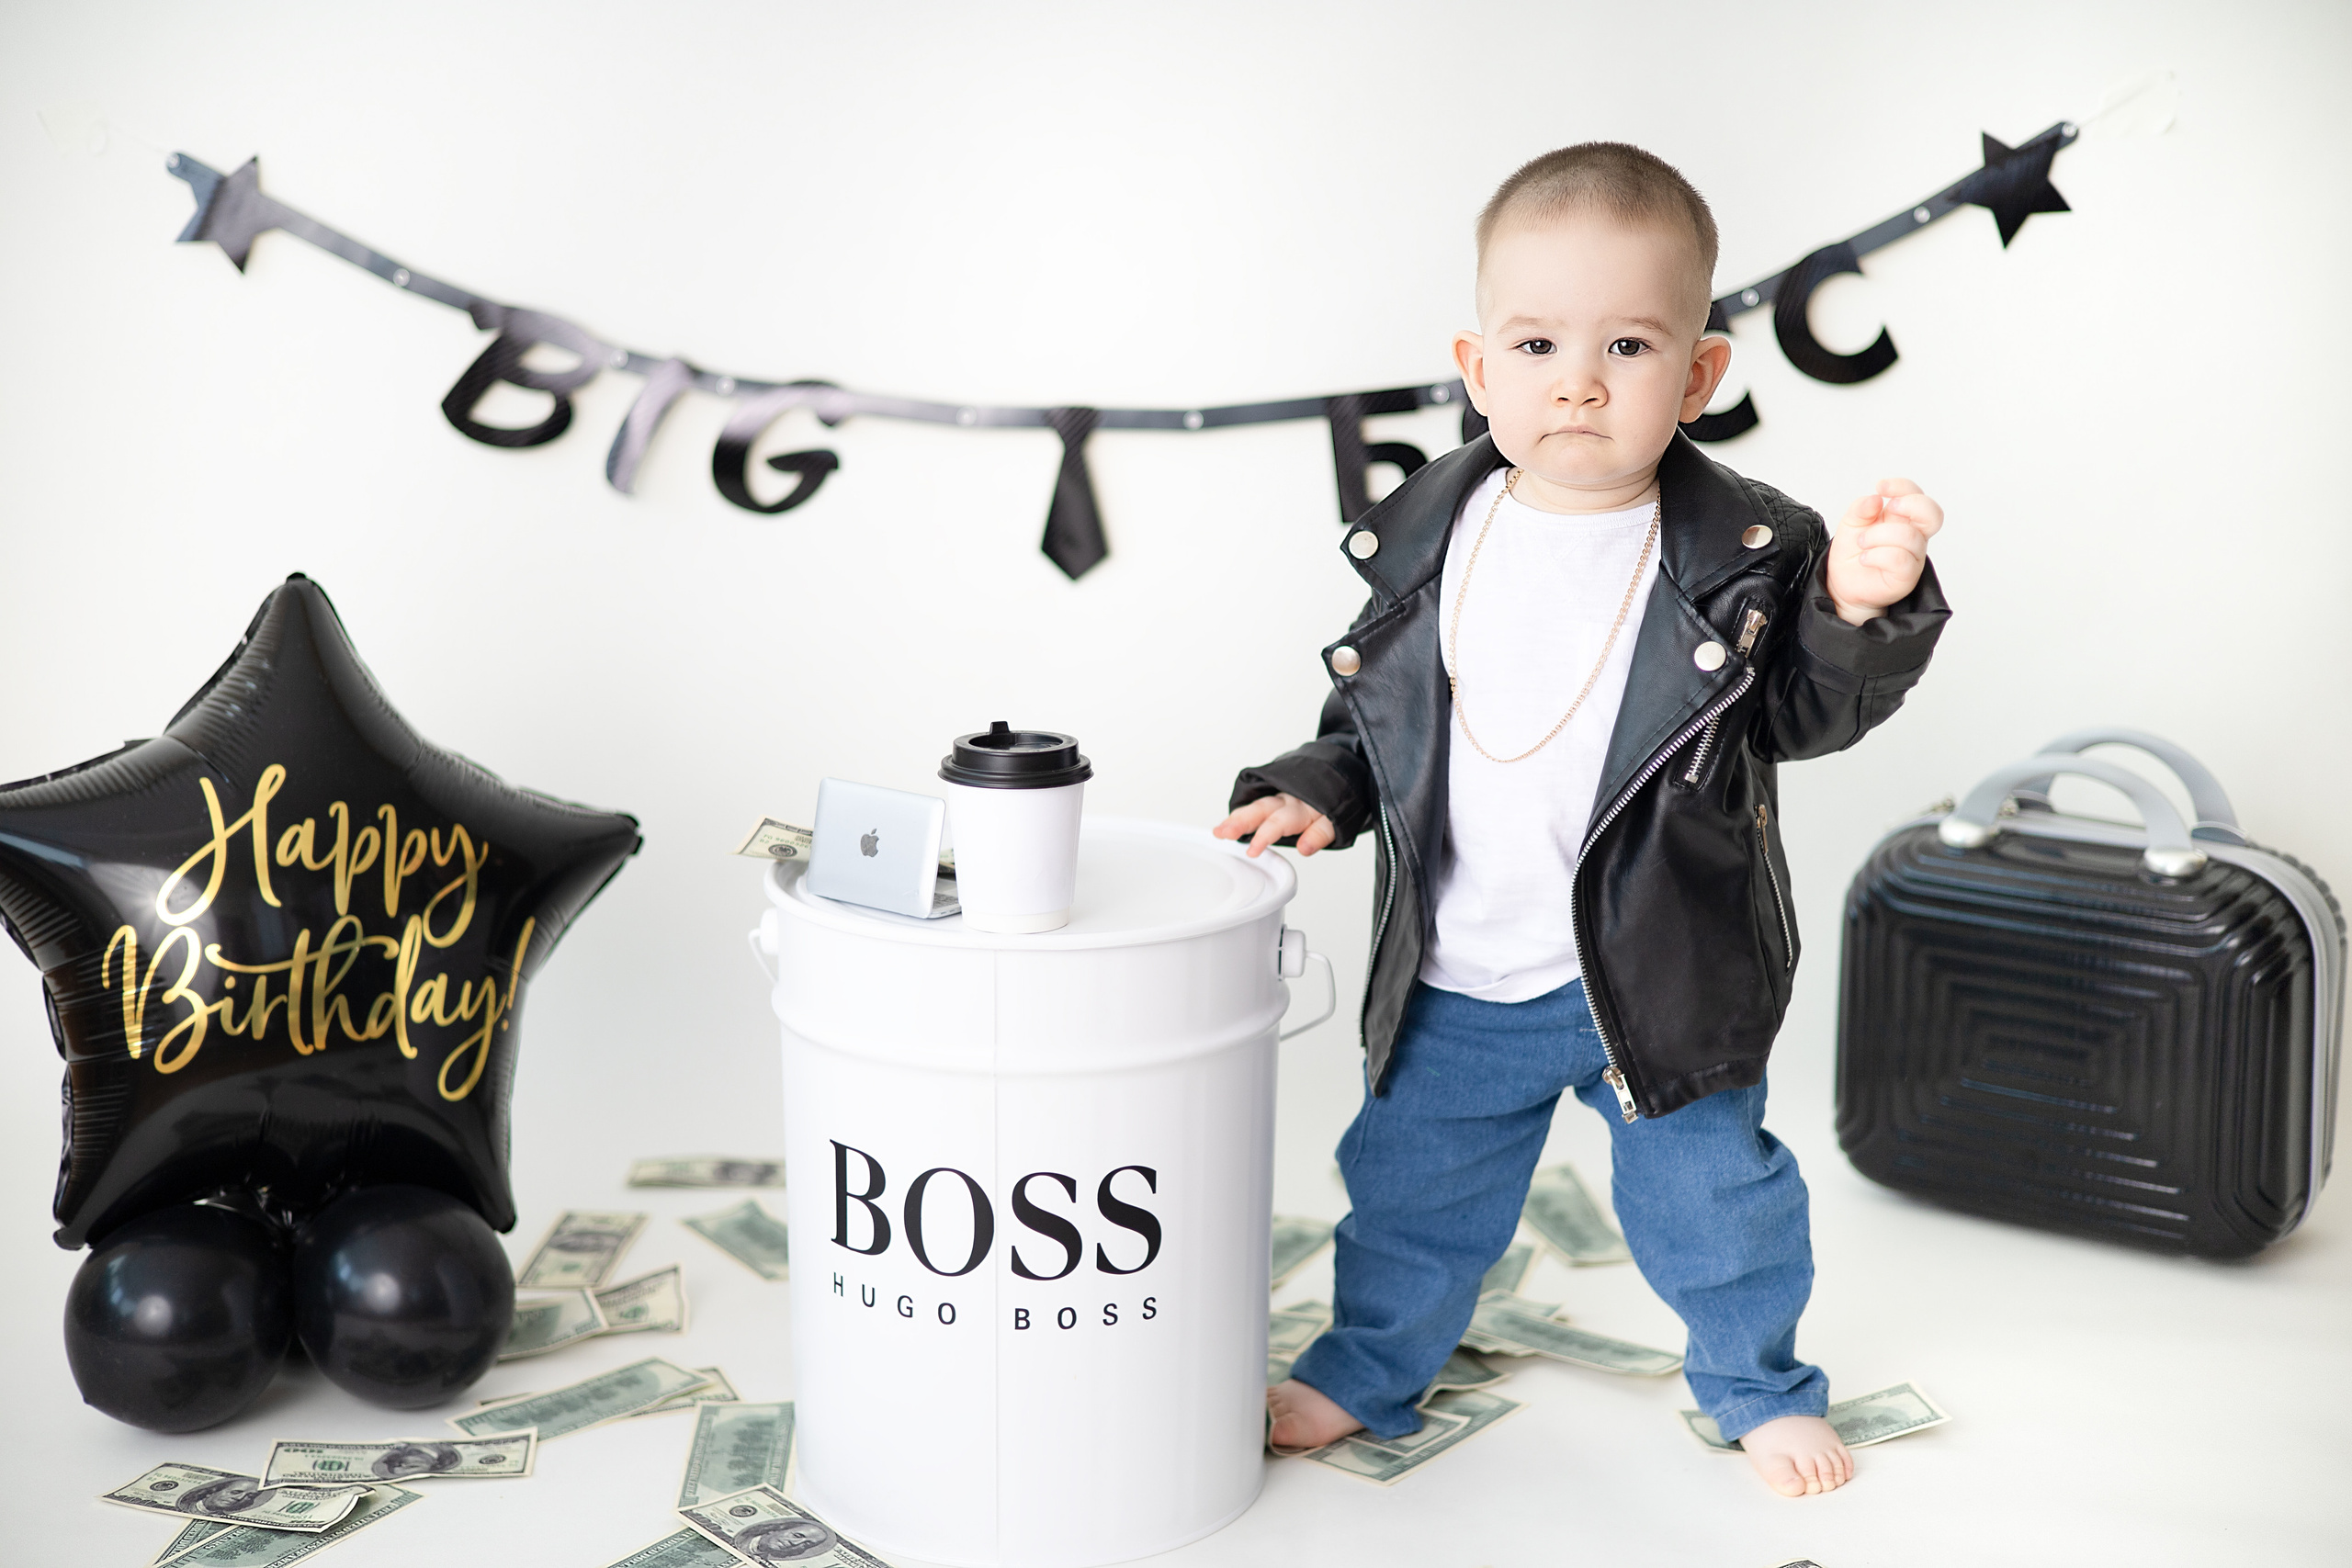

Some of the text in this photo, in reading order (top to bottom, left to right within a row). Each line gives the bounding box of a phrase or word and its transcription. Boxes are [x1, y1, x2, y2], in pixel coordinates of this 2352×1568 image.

[441, 300, 842, 513] BIG
[155, 763, 489, 948] Happy
[101, 914, 536, 1101] Birthday!
[830, 1139, 1162, 1281] BOSS
[833, 1272, 1158, 1331] HUGO BOSS
